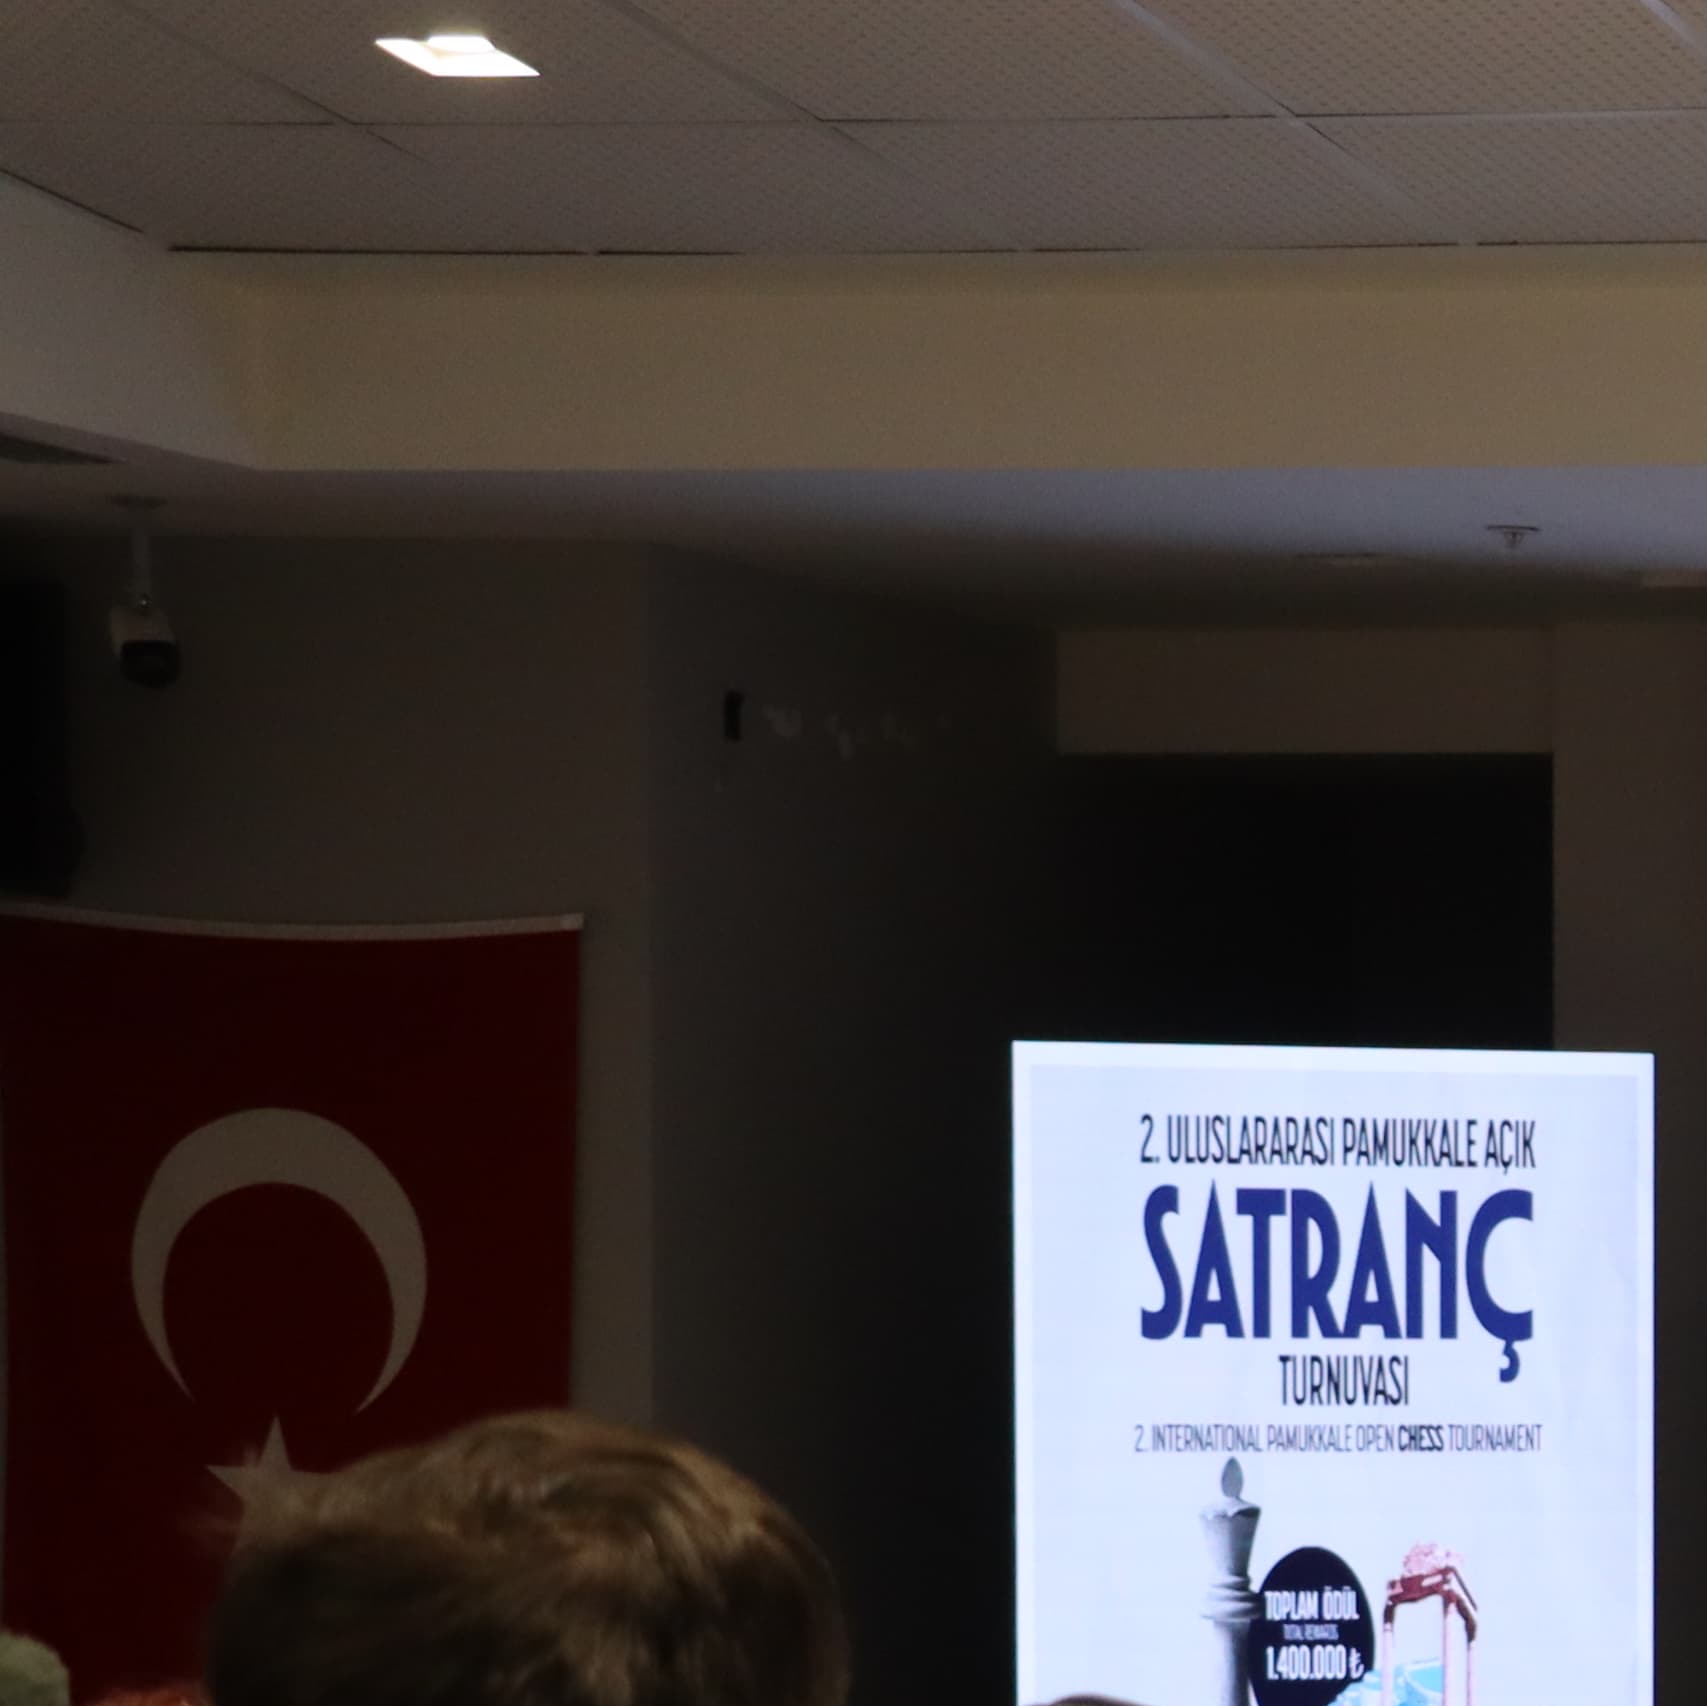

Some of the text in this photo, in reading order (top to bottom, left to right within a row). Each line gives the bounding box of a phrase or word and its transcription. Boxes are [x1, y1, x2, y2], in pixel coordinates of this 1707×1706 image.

[1139, 1113, 1537, 1175] 2. ULUSLARARASI PAMUKKALE AÇIK
[1140, 1179, 1534, 1384] SATRANÇ
[1278, 1354, 1410, 1407] TURNUVASI
[1152, 1423, 1263, 1454] INTERNATIONAL
[1266, 1423, 1352, 1454] PAMUKKALE
[1356, 1423, 1396, 1453] OPEN
[1397, 1423, 1445, 1453] CHESS
[1447, 1423, 1543, 1453] TOURNAMENT
[1263, 1585, 1361, 1621] TOPLAM ÖDÜL
[1266, 1644, 1347, 1681] 1.400.000
